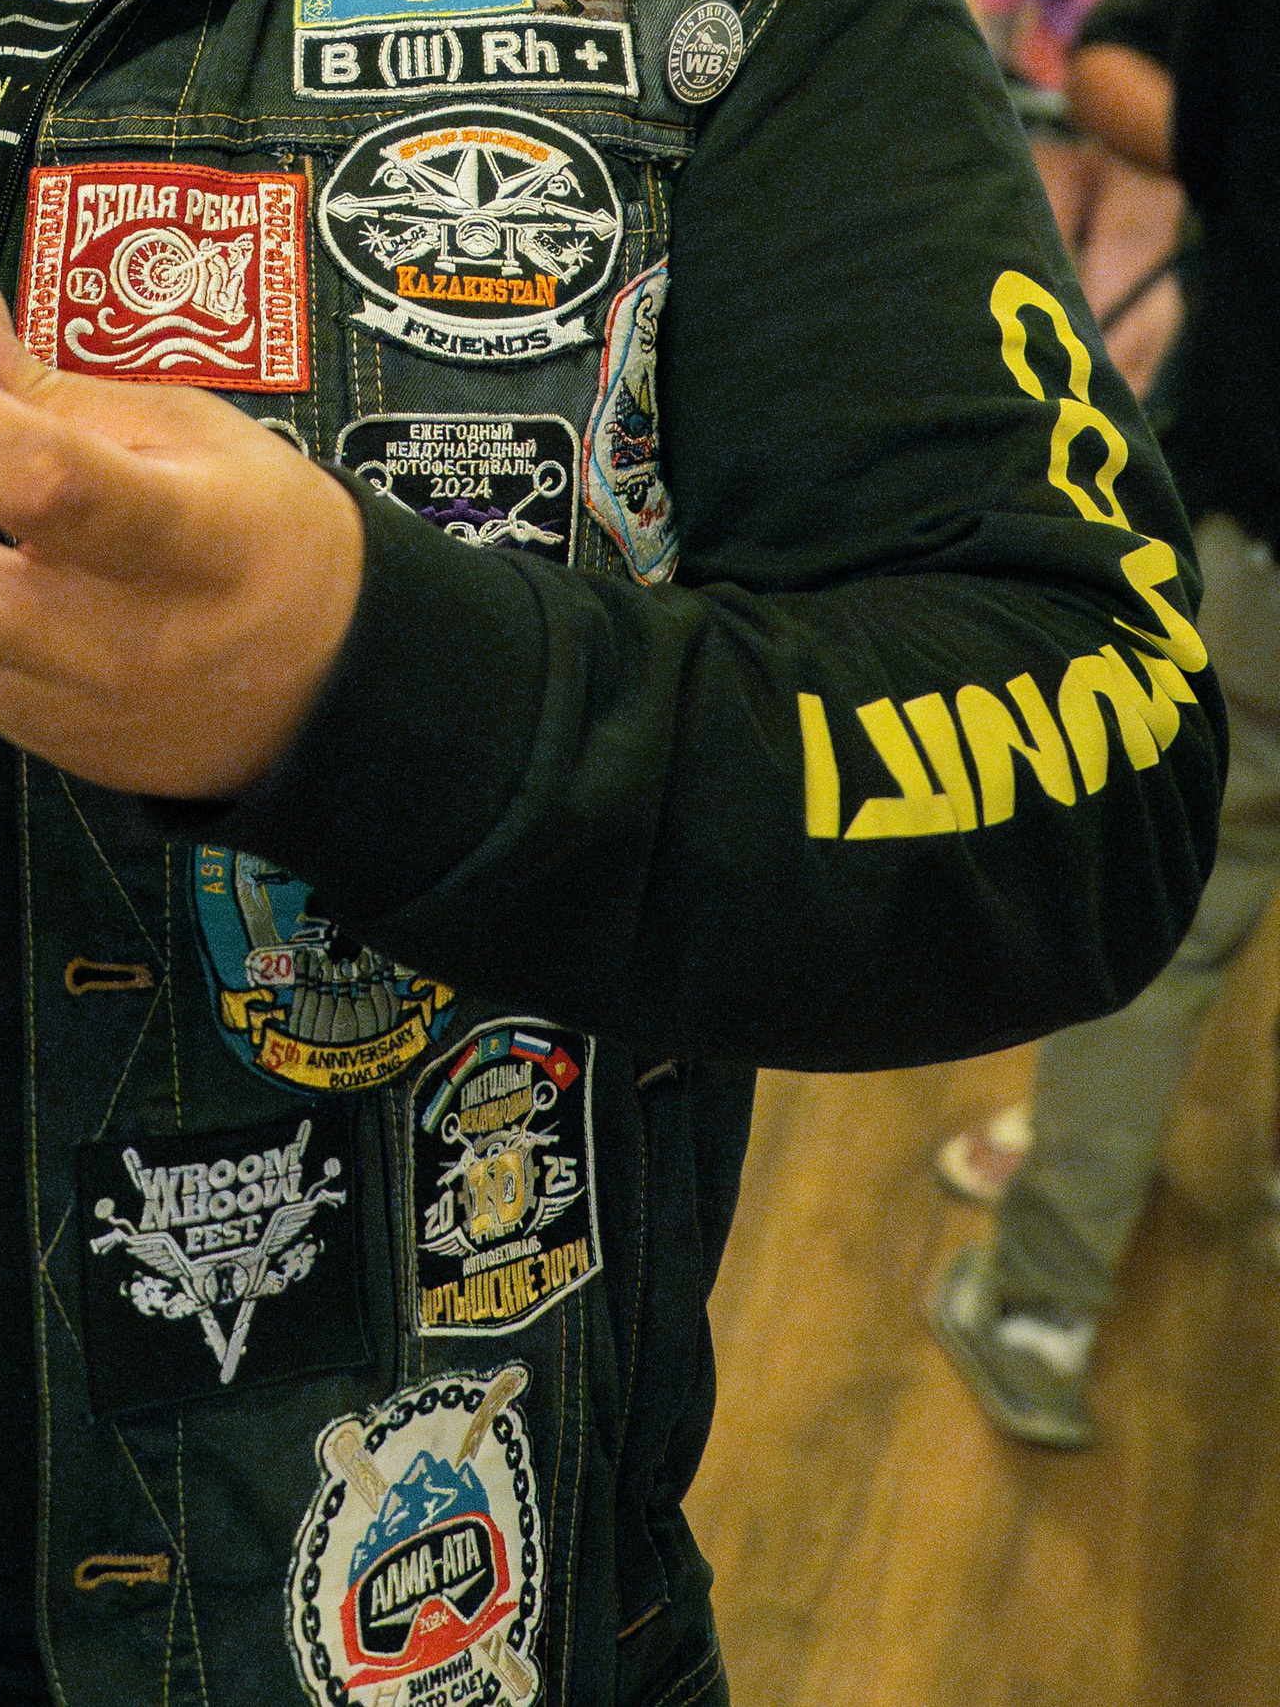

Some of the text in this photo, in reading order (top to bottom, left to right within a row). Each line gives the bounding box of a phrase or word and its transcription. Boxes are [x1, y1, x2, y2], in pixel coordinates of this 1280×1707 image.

[320, 42, 361, 85] B
[482, 28, 561, 75] Rh
[685, 53, 723, 75] WB
[70, 183, 260, 262] БЕЛАЯ РЕКА
[74, 273, 101, 301] 14
[396, 265, 558, 309] KAZAKHSTAN
[265, 247, 292, 378] ПАВЛОДАР
[401, 317, 553, 356] FRIENDS
[386, 438, 537, 459] МЕЖДУНАРОДНЫЙ
[409, 422, 514, 441] ЕЖЕГОДНЫЙ
[386, 458, 536, 477] МОТОФЕСТИВАЛЬ
[429, 477, 493, 500] 2024
[306, 1023, 418, 1069] ANNIVERSARY
[329, 1054, 404, 1089] BOWLING
[542, 1155, 578, 1195] 25
[185, 1213, 263, 1255] FEST
[424, 1190, 455, 1241] 20
[371, 1527, 483, 1617] АЛМА-АТА
